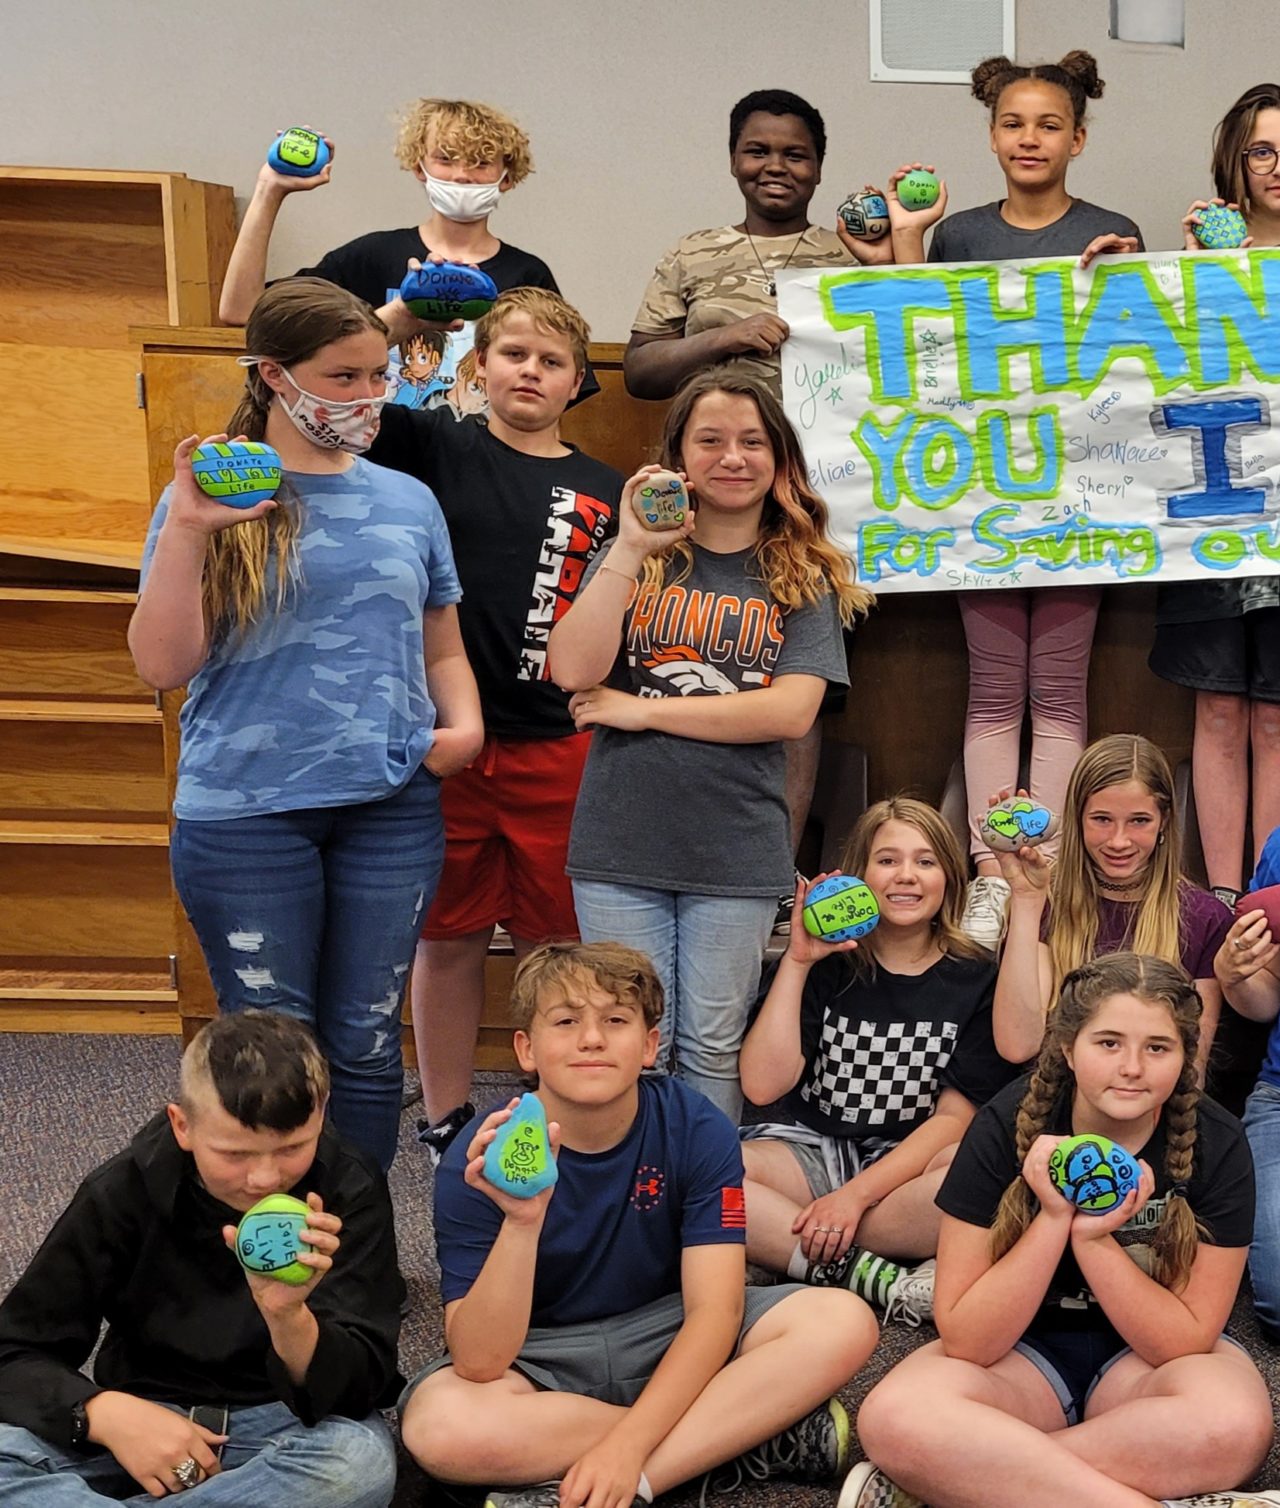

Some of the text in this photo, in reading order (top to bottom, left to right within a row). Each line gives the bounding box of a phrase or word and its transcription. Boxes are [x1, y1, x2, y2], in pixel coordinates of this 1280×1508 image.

[319, 423, 348, 446] STAY
[851, 405, 1063, 510] YOU
[858, 516, 955, 581] For
[965, 503, 1162, 577] Saving
[626, 583, 785, 671] RONCOS
